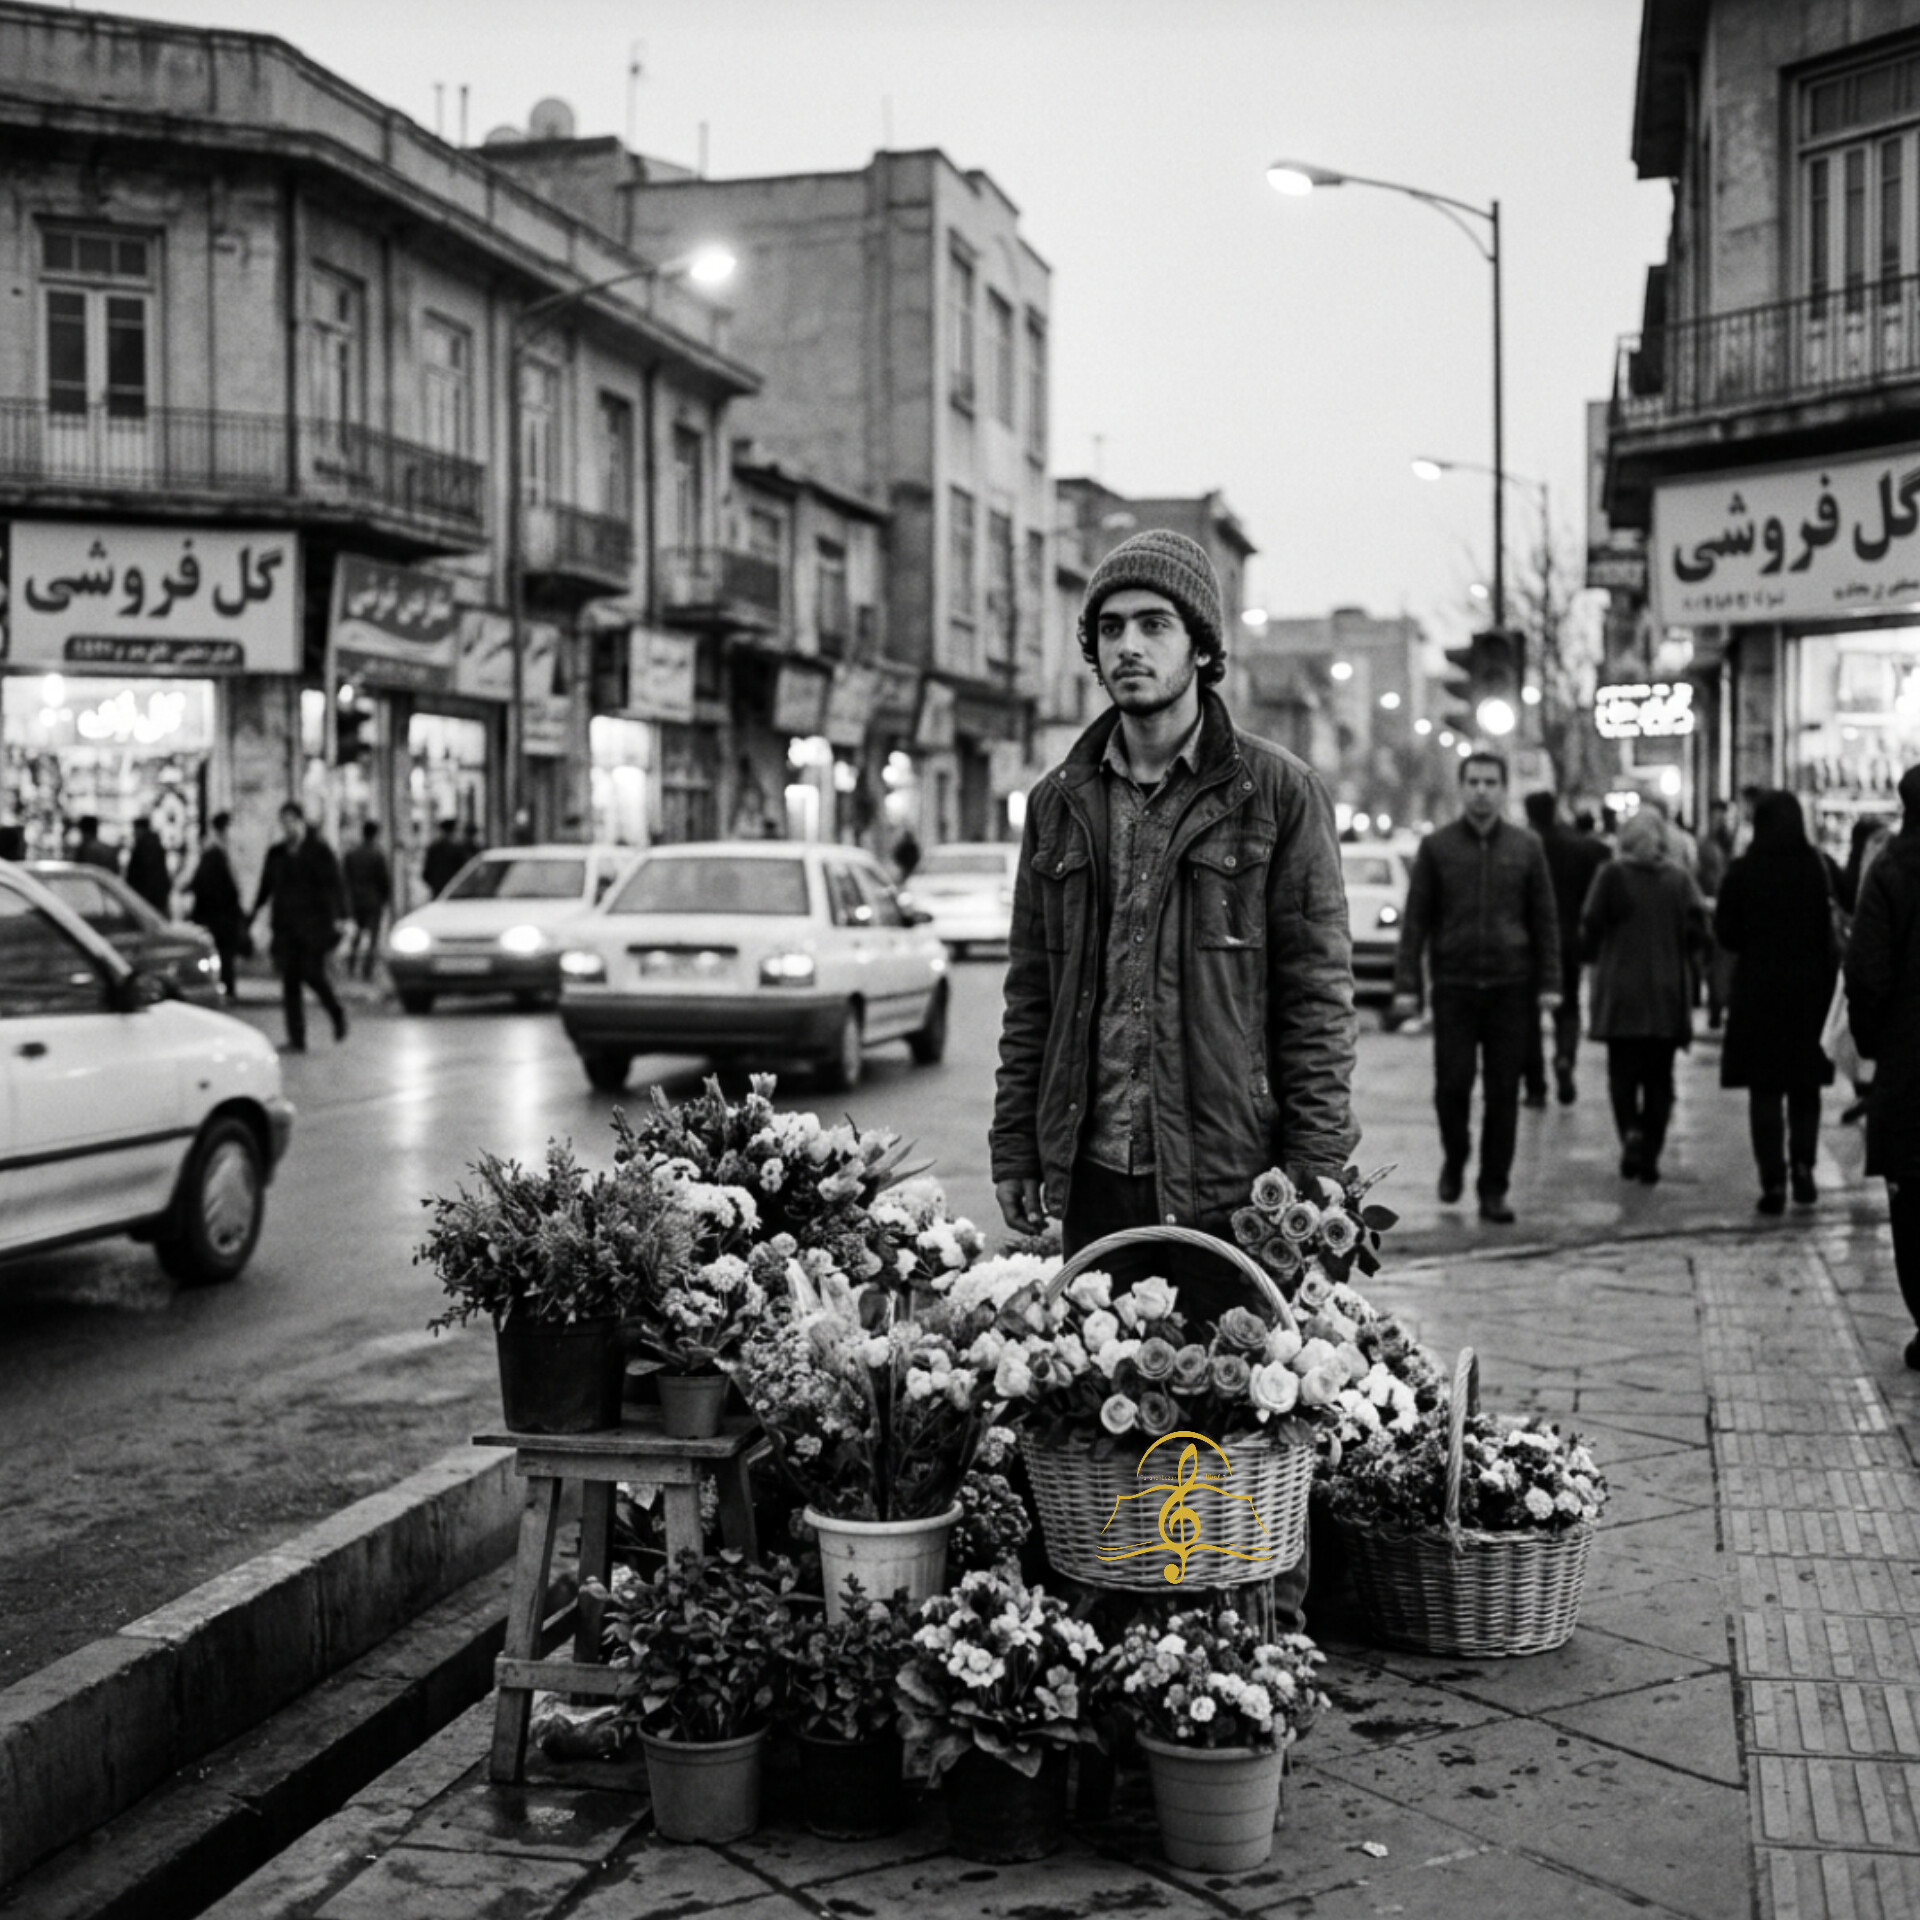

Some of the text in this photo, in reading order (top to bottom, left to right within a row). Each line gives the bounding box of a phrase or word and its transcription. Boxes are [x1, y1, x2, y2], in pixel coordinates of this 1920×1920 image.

[1672, 467, 1920, 584] گل فروشی
[24, 536, 201, 618] فروشی
[212, 544, 284, 618] گل
